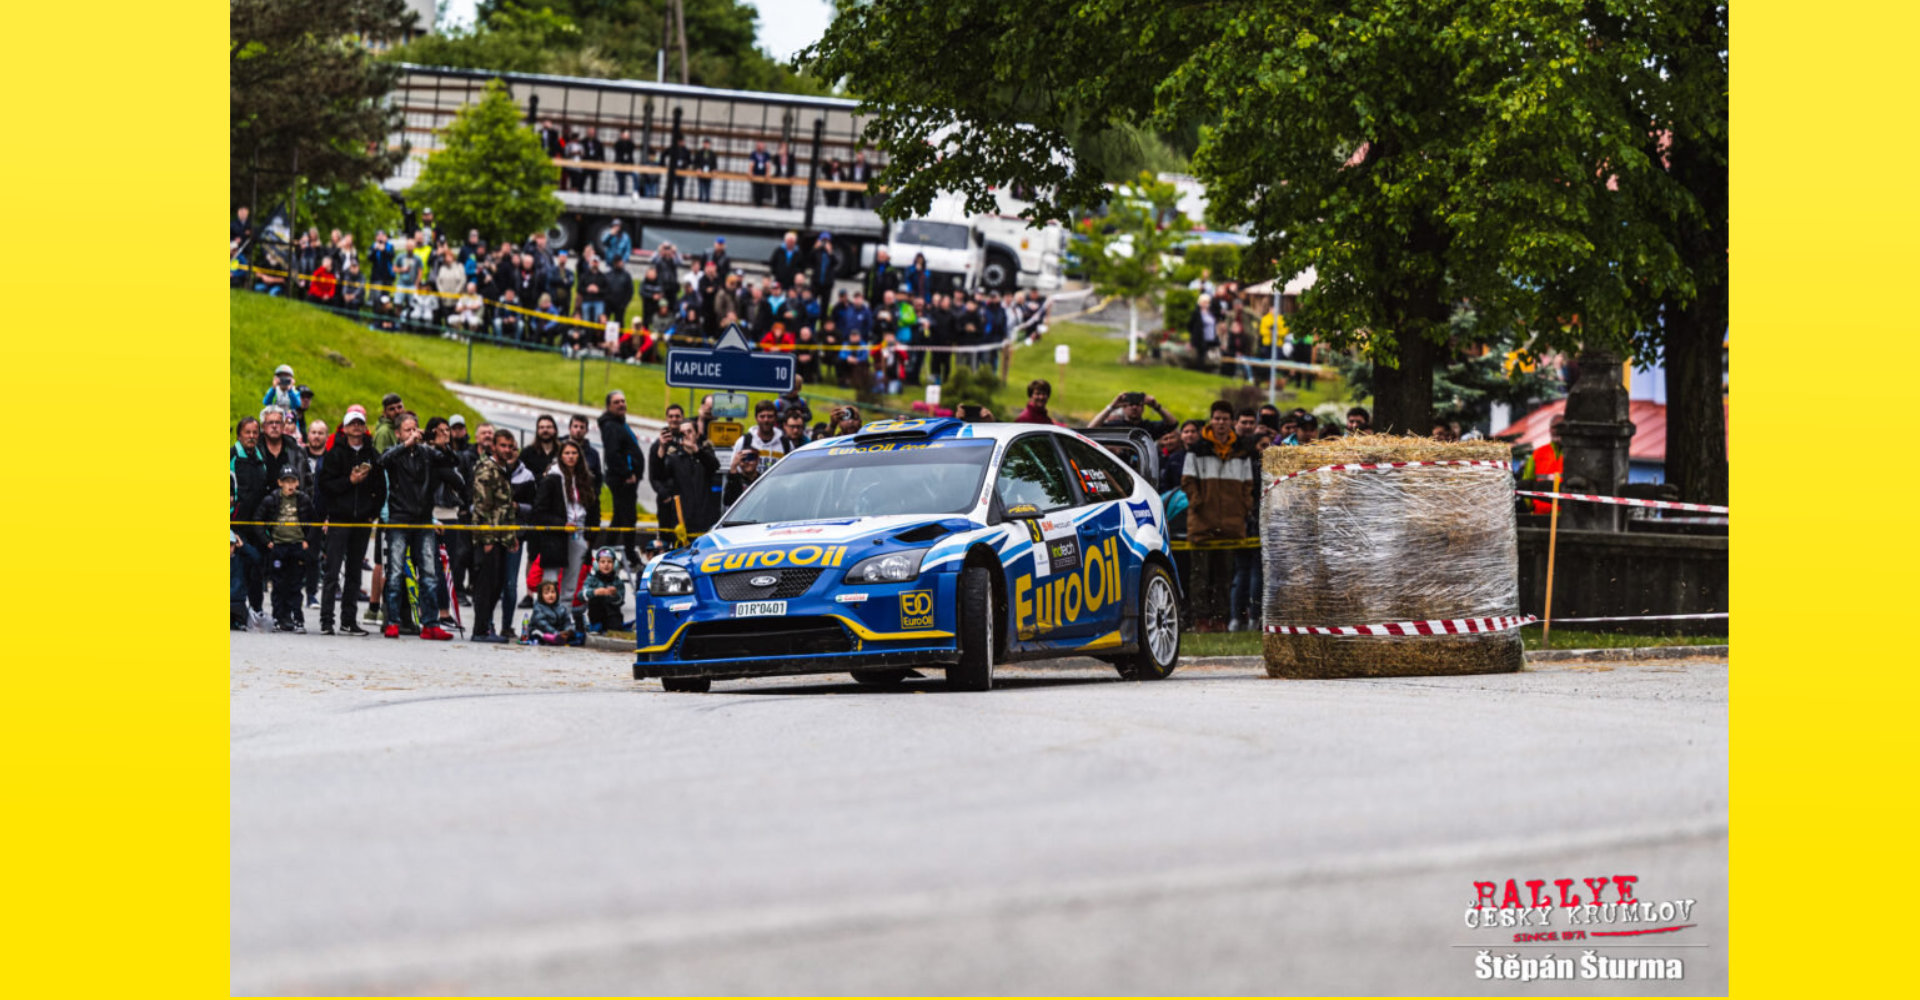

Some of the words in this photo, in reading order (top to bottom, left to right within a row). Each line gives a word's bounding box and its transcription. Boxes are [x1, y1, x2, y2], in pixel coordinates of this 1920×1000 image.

[674, 361, 722, 377] KAPLICE
[775, 366, 788, 381] 10
[1027, 518, 1041, 542] 3
[700, 545, 848, 573] EuroOil
[1015, 536, 1121, 641] EuroOil
[903, 614, 933, 626] EuroOil
